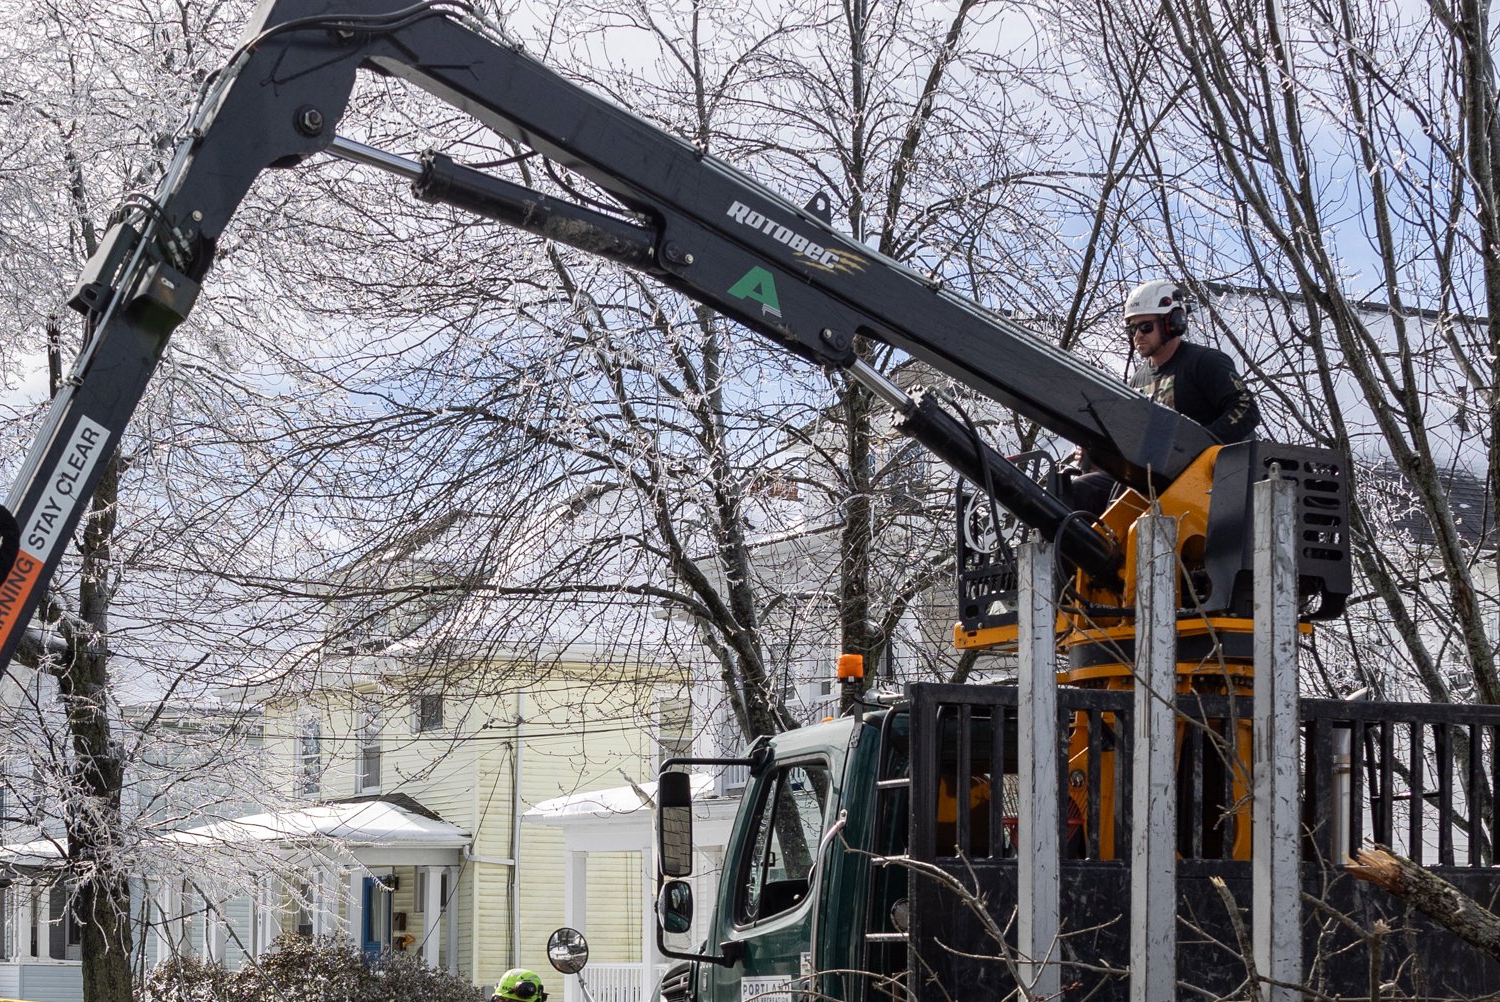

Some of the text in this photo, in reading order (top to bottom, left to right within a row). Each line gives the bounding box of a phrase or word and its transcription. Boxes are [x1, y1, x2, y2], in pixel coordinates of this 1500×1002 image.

[28, 496, 63, 551] STAY
[55, 426, 100, 496] CLEAR
[743, 983, 790, 996] PORTLAND
